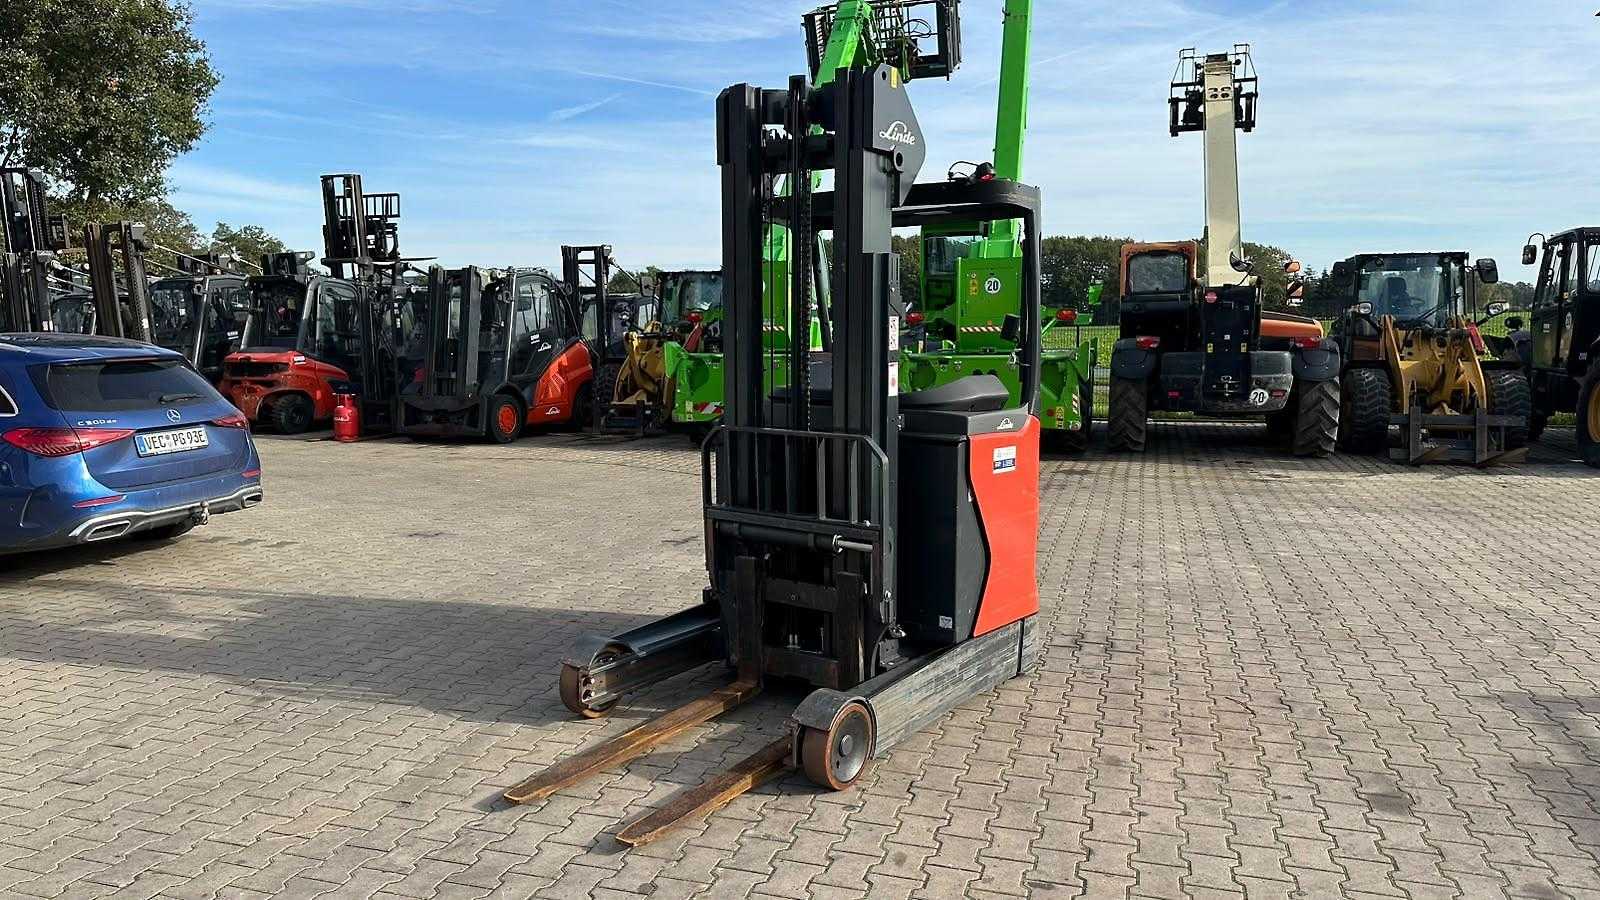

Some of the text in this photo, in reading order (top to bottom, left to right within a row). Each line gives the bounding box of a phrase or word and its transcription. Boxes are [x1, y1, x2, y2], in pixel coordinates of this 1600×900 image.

[880, 121, 915, 145] Linde
[987, 280, 999, 291] 20
[1253, 392, 1265, 403] 20
[144, 430, 206, 450] VEC PG 93E
